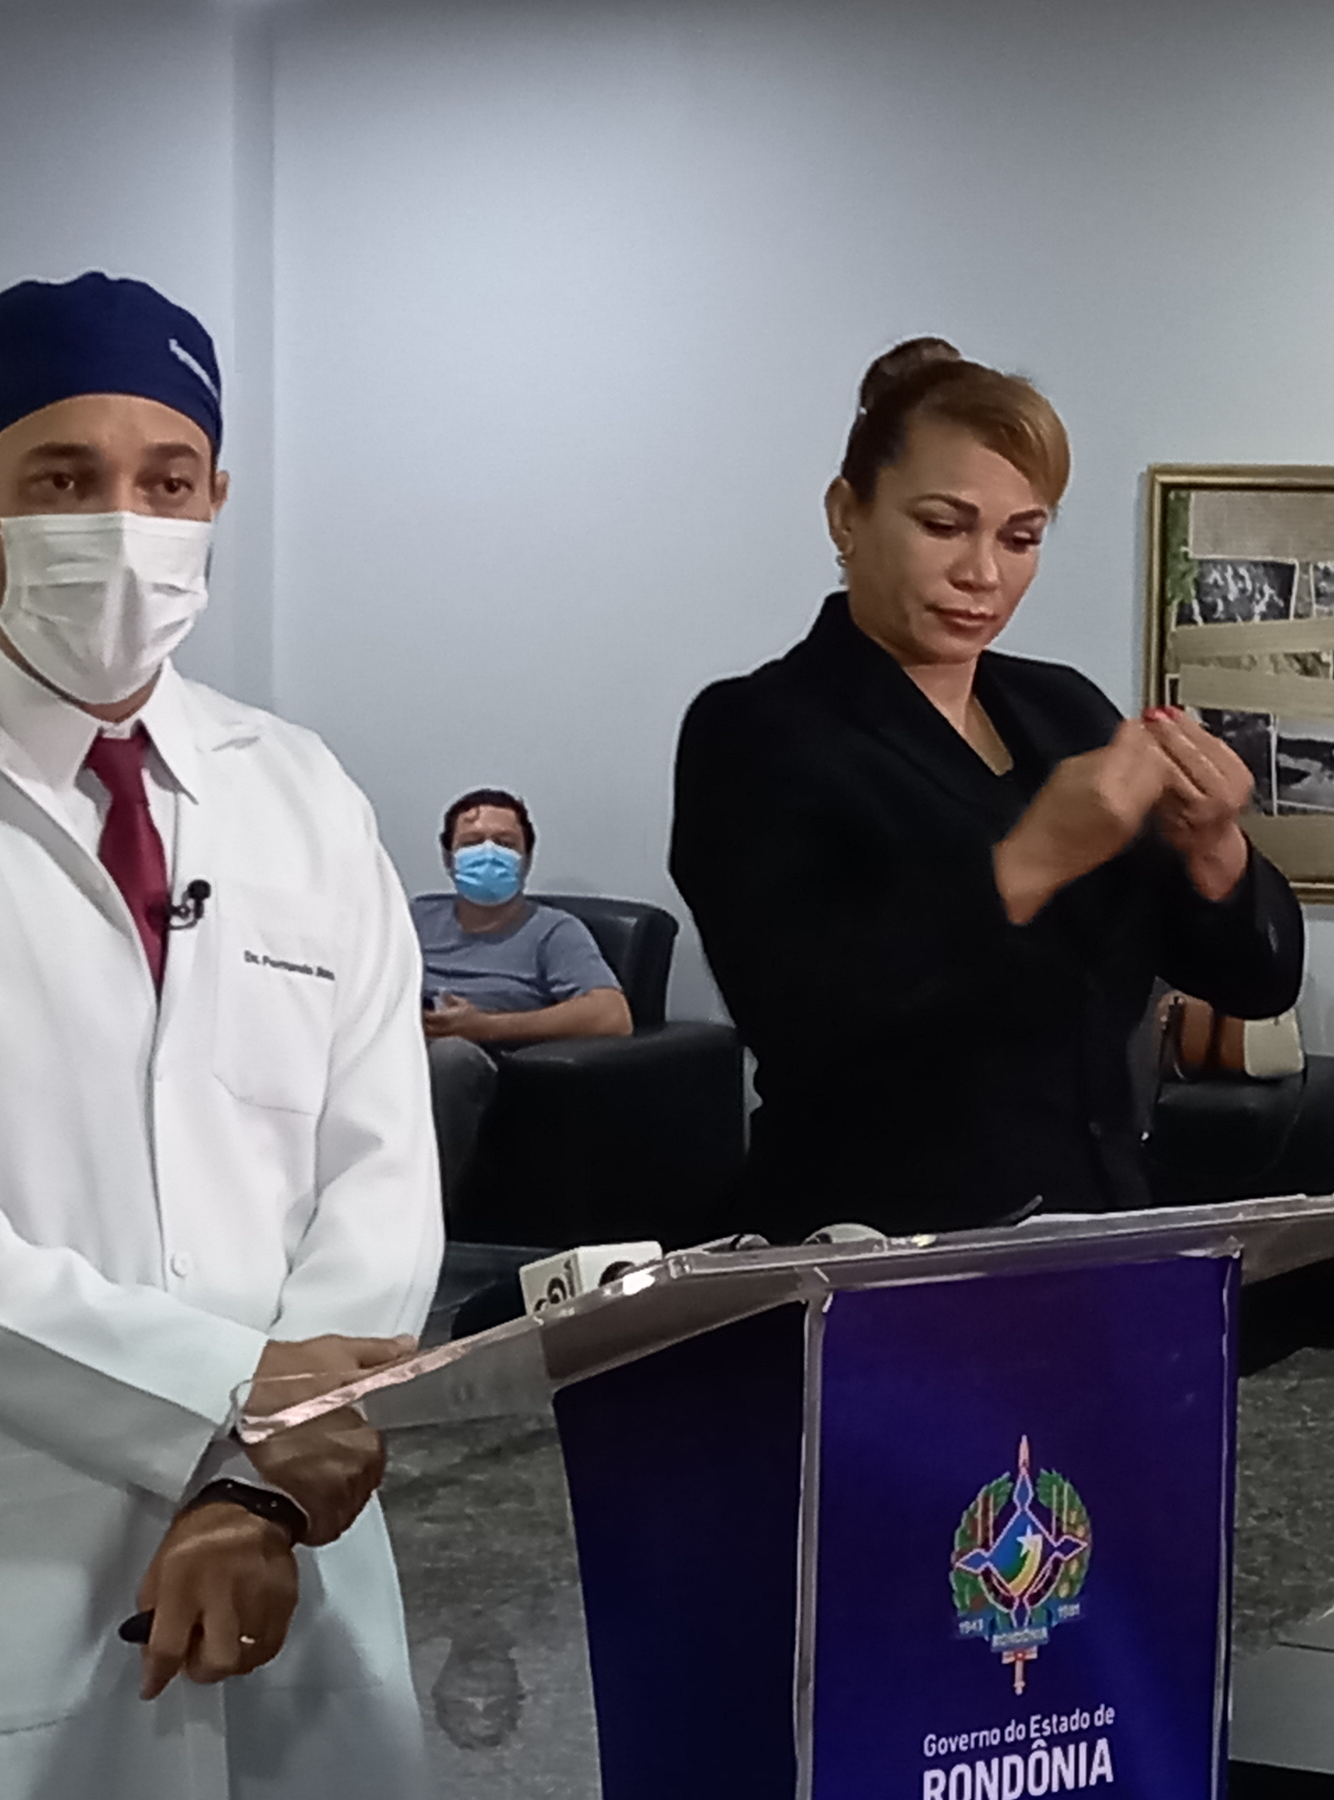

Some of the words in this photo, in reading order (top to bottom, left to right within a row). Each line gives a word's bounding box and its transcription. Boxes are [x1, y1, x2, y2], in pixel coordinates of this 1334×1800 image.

[923, 1728, 1001, 1757] Governo
[1004, 1719, 1026, 1743] do
[1029, 1708, 1090, 1739] Estado
[1094, 1703, 1116, 1727] de
[923, 1738, 1114, 1800] RONDÔNIA
